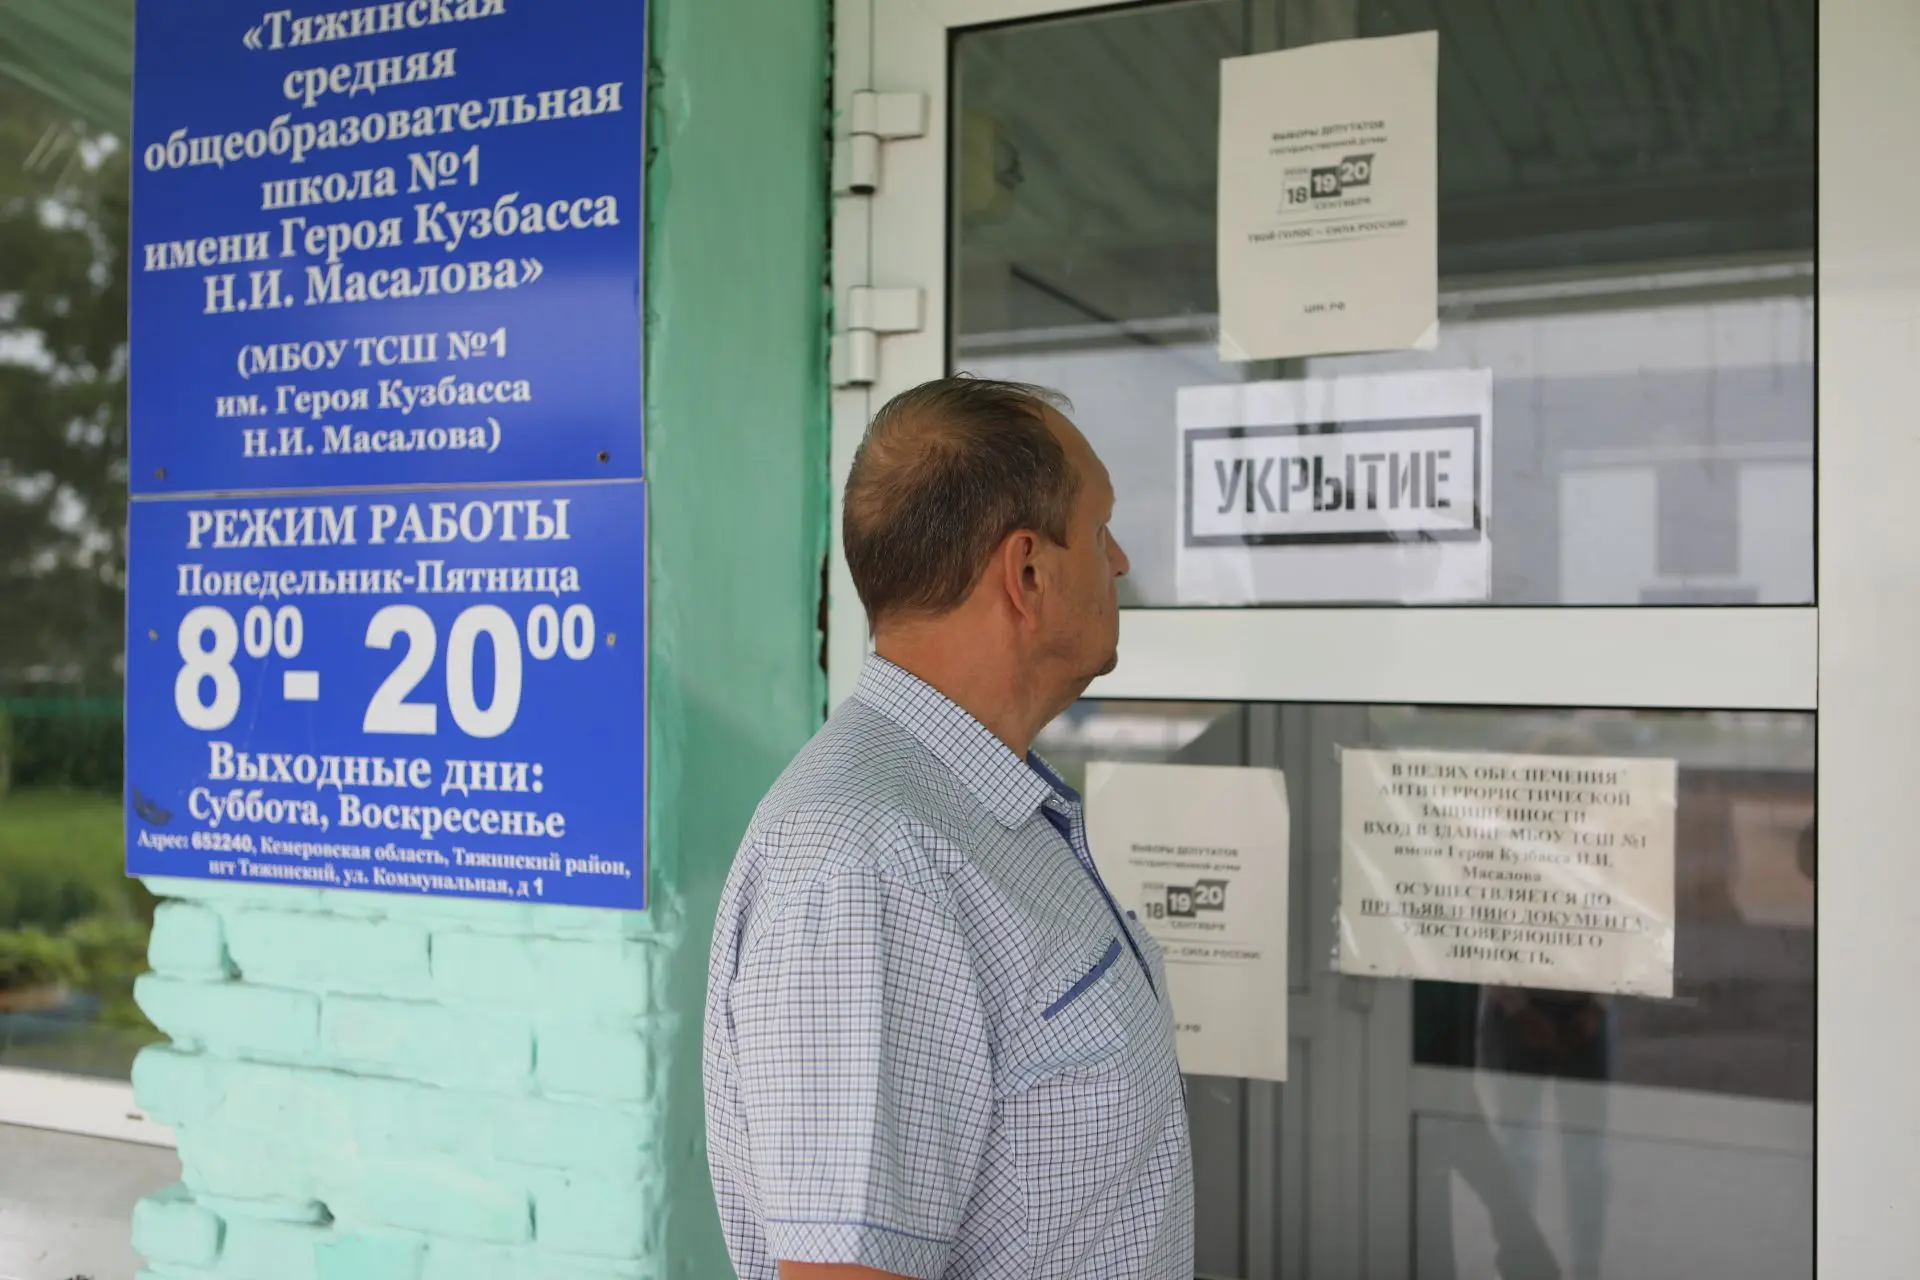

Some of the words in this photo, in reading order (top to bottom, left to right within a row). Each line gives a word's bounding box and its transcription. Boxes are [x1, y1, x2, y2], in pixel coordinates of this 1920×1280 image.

[283, 48, 458, 109] средняя
[144, 81, 622, 171] общеобразовательная
[261, 165, 397, 210] школа
[407, 145, 481, 194] №1
[1286, 186, 1309, 205] 18
[1313, 173, 1338, 193] 19
[1341, 161, 1369, 182] 20
[144, 231, 269, 271] имени
[280, 216, 402, 265] Героя
[413, 191, 620, 251] Кузбасса
[203, 270, 294, 315] Н.И.
[305, 255, 543, 306] Масалова»
[237, 342, 348, 378] (МБОУ
[354, 333, 438, 367] ТСШ
[447, 327, 507, 359] №1
[216, 394, 267, 417] им.
[275, 386, 368, 420] Героя
[377, 375, 531, 414] Кузбасса
[242, 428, 314, 457] Н.И.
[322, 418, 500, 453] Масалова)
[1214, 450, 1451, 514] УКРЫТИЕ
[186, 504, 357, 550] РЕЖИМ
[368, 498, 571, 545] РАБОТЫ
[177, 559, 579, 600] Понедельник-Пятница
[208, 741, 431, 791] Выходные
[441, 761, 543, 796] дни:
[1391, 763, 1403, 777] В
[1474, 767, 1618, 786] ОБЕСПЕЧЕНИЯ
[188, 787, 328, 832] Суббота,
[338, 793, 565, 839] Воскресенье
[1378, 783, 1631, 806] АНТИТЕРРОРИСТИЧЕСКОЙ
[137, 829, 188, 852] Адрес:
[260, 836, 370, 860] Кемеровская
[375, 842, 449, 867] область,
[452, 846, 560, 872] Тяжинский
[565, 854, 631, 879] район,
[1363, 821, 1410, 838] ВХОД
[1509, 828, 1564, 846] МБОУ
[1572, 831, 1615, 847] ТСШ
[209, 860, 236, 875] пгт
[238, 858, 340, 884] Тяжинский,
[343, 868, 369, 886] ул.
[373, 867, 514, 895] Коммунальная,
[517, 883, 529, 897] д
[534, 877, 544, 896] 1
[1462, 865, 1542, 883] Масалова
[1145, 902, 1165, 919] 18
[1169, 893, 1192, 912] 19
[1196, 885, 1223, 905] 20
[1582, 891, 1612, 906] ПО
